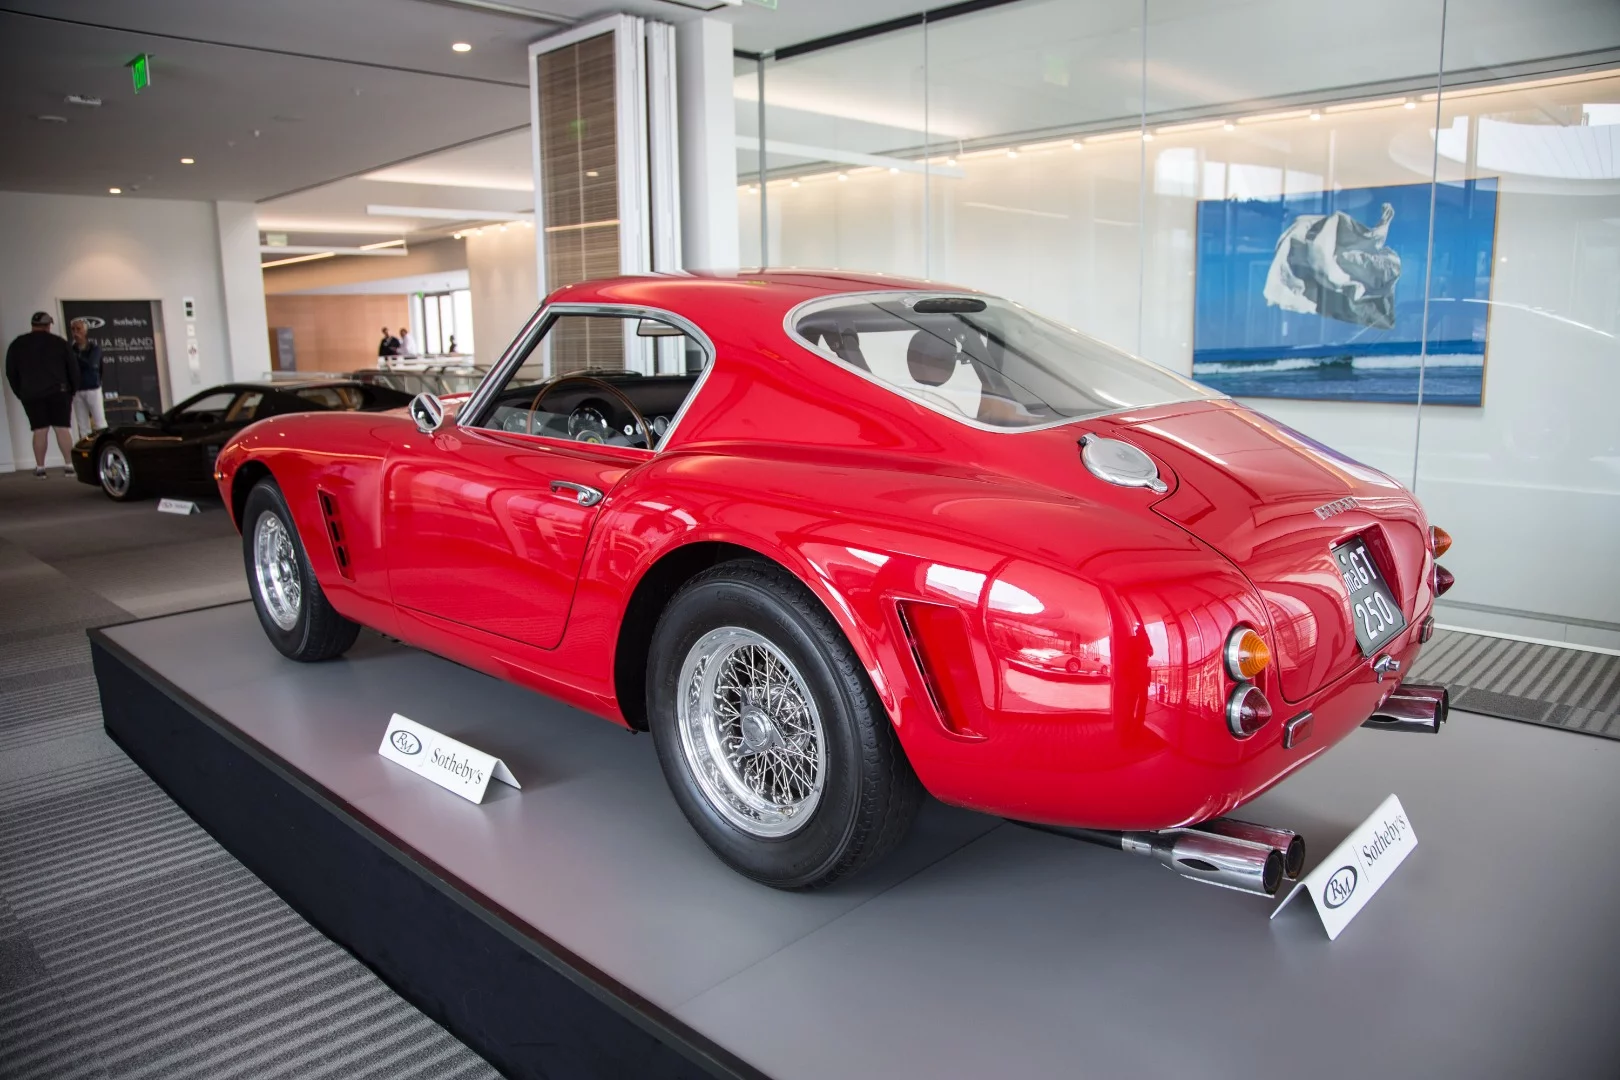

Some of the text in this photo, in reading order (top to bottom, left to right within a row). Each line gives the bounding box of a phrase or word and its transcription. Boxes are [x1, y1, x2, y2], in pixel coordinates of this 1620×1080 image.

[115, 336, 153, 347] ISLAND
[118, 355, 146, 363] TODAY
[1354, 591, 1394, 641] 250
[396, 732, 484, 785] RM Sotheby's
[1329, 814, 1406, 901] RM Sotheby's
